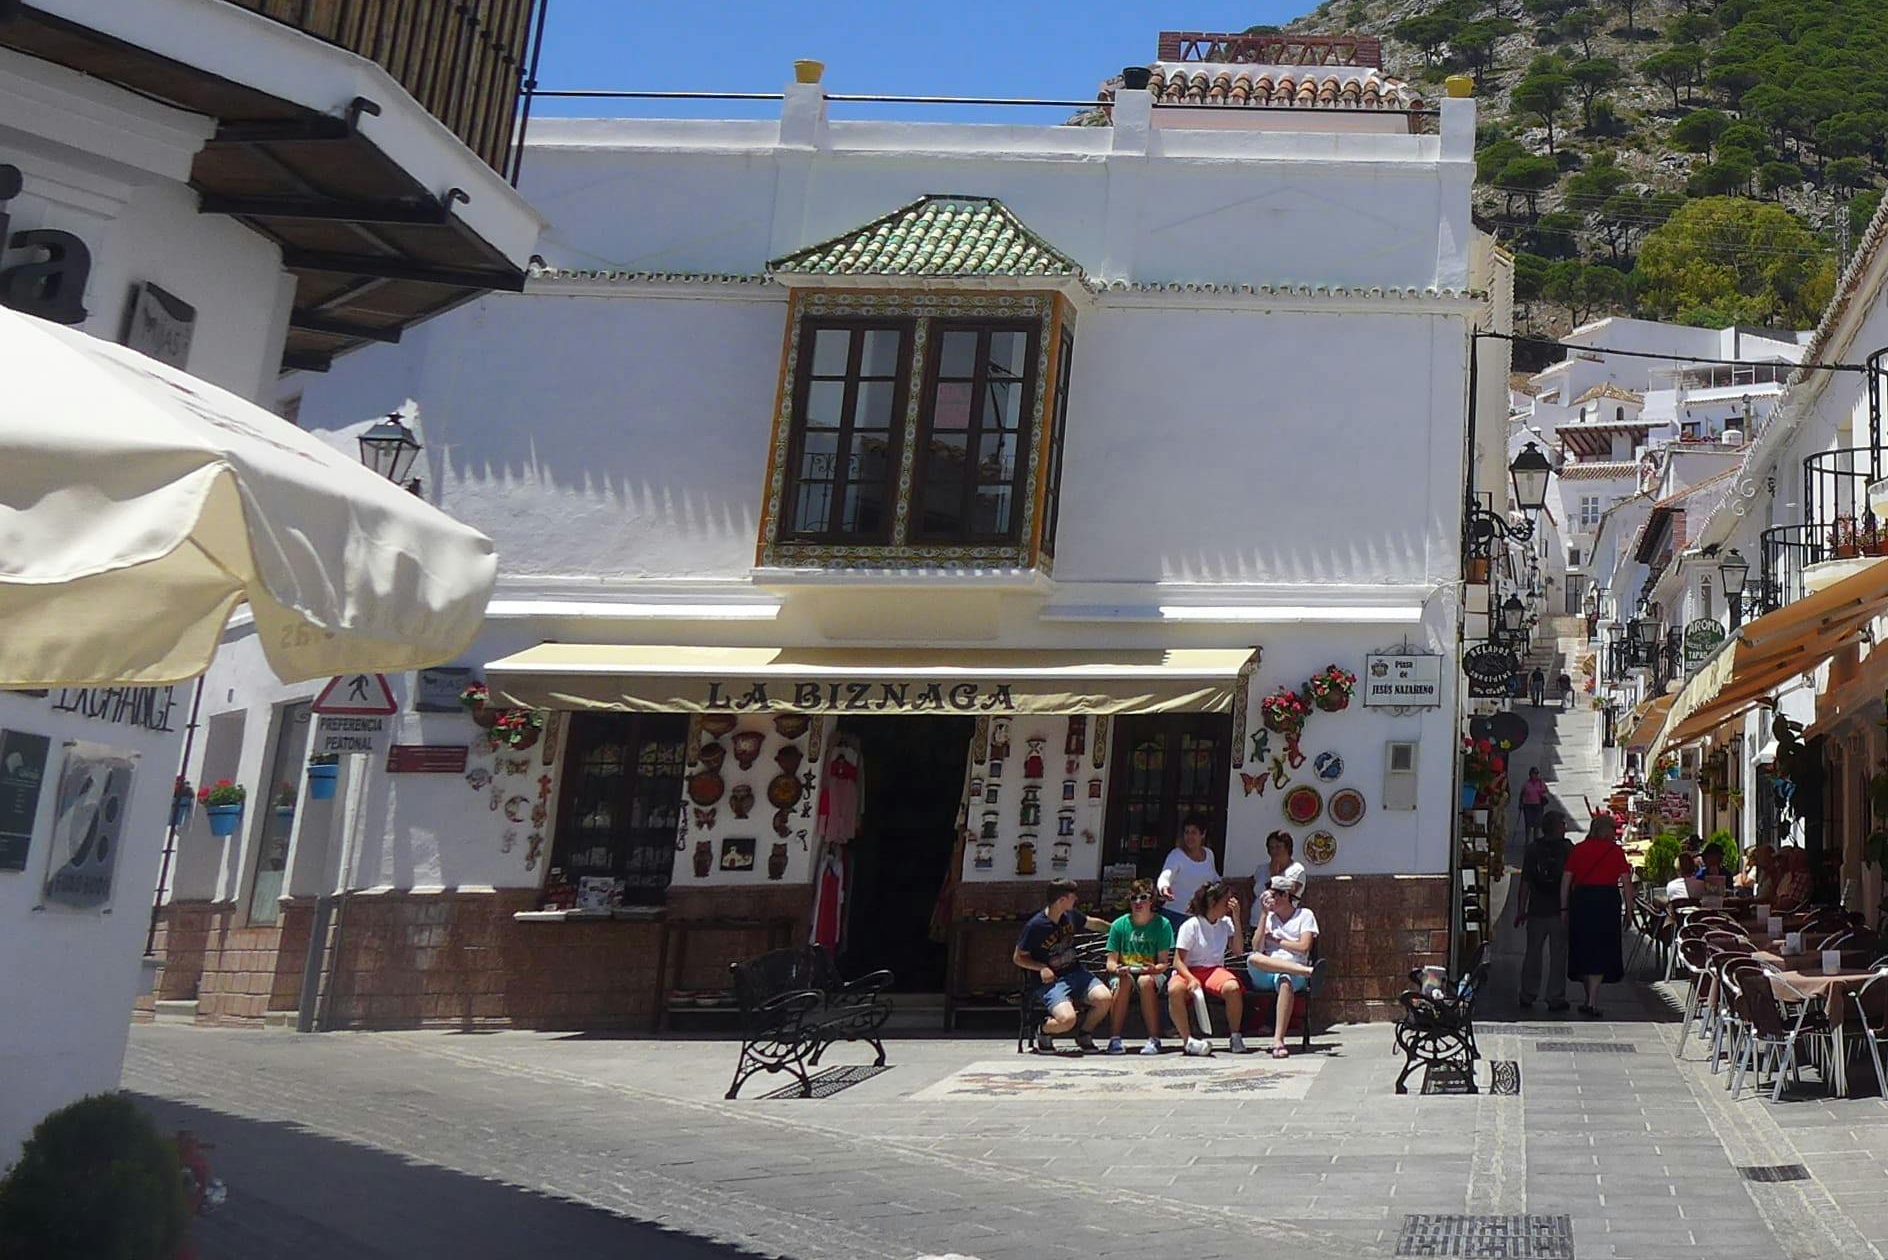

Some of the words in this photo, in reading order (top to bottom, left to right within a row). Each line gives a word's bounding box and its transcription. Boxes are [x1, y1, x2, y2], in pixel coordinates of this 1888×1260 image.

[1688, 620, 1723, 636] AROMA
[708, 682, 771, 710] LA
[791, 682, 1017, 710] BIZNAGA
[320, 716, 383, 732] PREFERENCIA
[325, 736, 373, 751] PEATONAL
